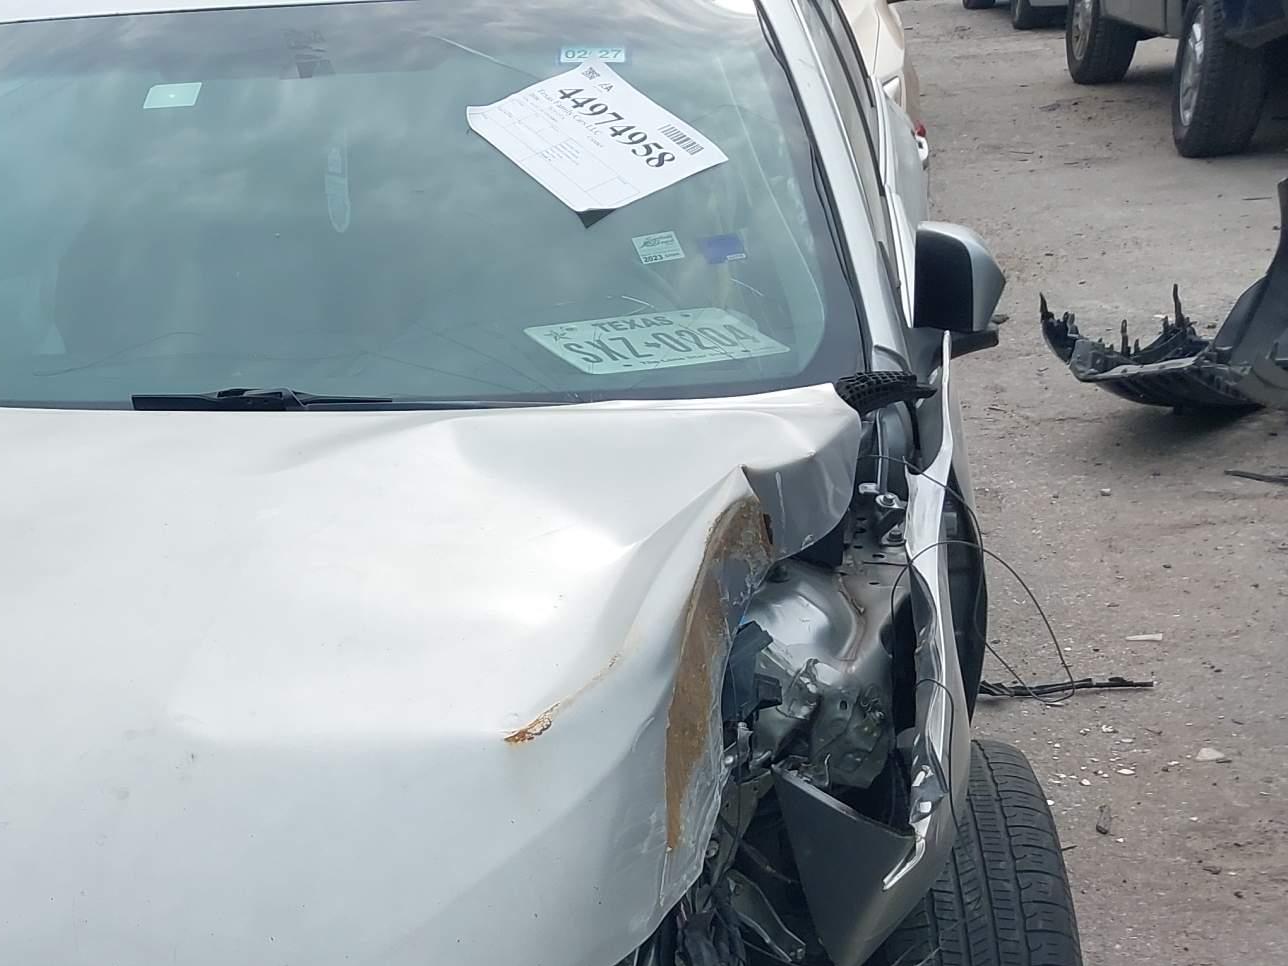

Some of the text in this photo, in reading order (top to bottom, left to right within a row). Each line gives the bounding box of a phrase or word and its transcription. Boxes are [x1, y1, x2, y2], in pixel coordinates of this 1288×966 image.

[558, 88, 676, 168] 44974958
[642, 253, 664, 263] 2023
[592, 316, 674, 332] TEXAS
